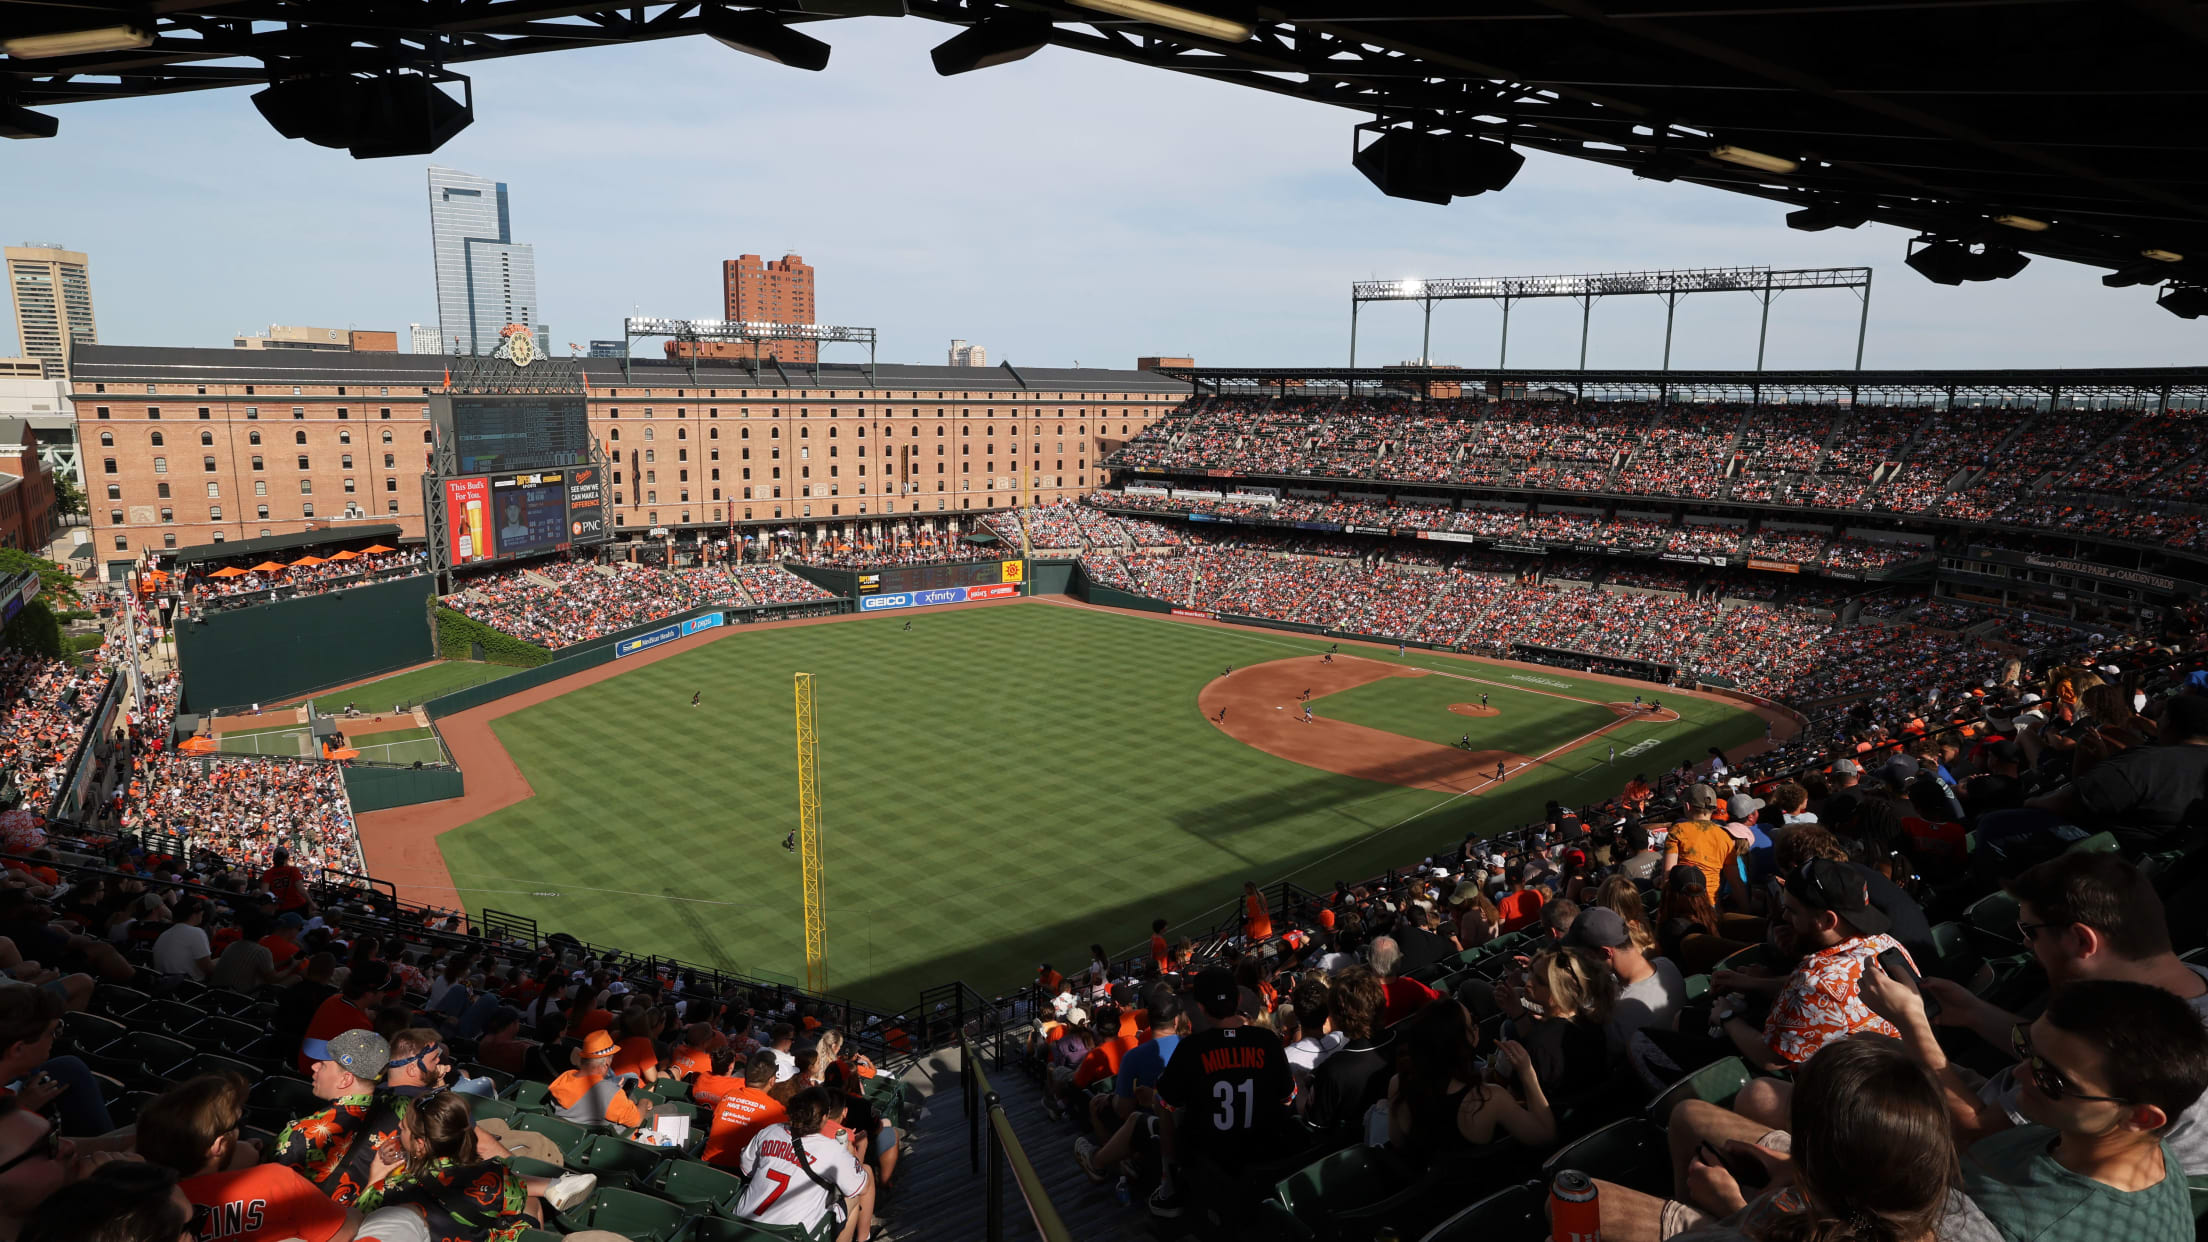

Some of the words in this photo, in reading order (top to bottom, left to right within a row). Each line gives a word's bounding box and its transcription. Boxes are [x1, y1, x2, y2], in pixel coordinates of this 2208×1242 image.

[450, 483, 466, 491] This
[467, 481, 484, 489] Bud's
[580, 484, 591, 492] HOW
[582, 492, 595, 500] MAKE
[571, 499, 600, 509] DIFFERENCE
[583, 520, 601, 532] PNC
[1832, 570, 1856, 579] Fanatics
[2056, 560, 2088, 573] ORIOLE
[2088, 566, 2109, 577] PARK
[2116, 570, 2151, 584] CAMDEN
[2151, 577, 2174, 590] YARDS
[866, 596, 906, 608] GEICO
[925, 591, 956, 603] xfinity
[697, 617, 712, 630] pepsi
[660, 630, 675, 640] Health
[1201, 1047, 1265, 1073] MULLINS
[727, 1102, 740, 1110] HAVE
[741, 1105, 756, 1113] YOU?
[736, 1098, 759, 1108] CHECKED
[1213, 1078, 1254, 1130] 31
[753, 1168, 791, 1216] 7
